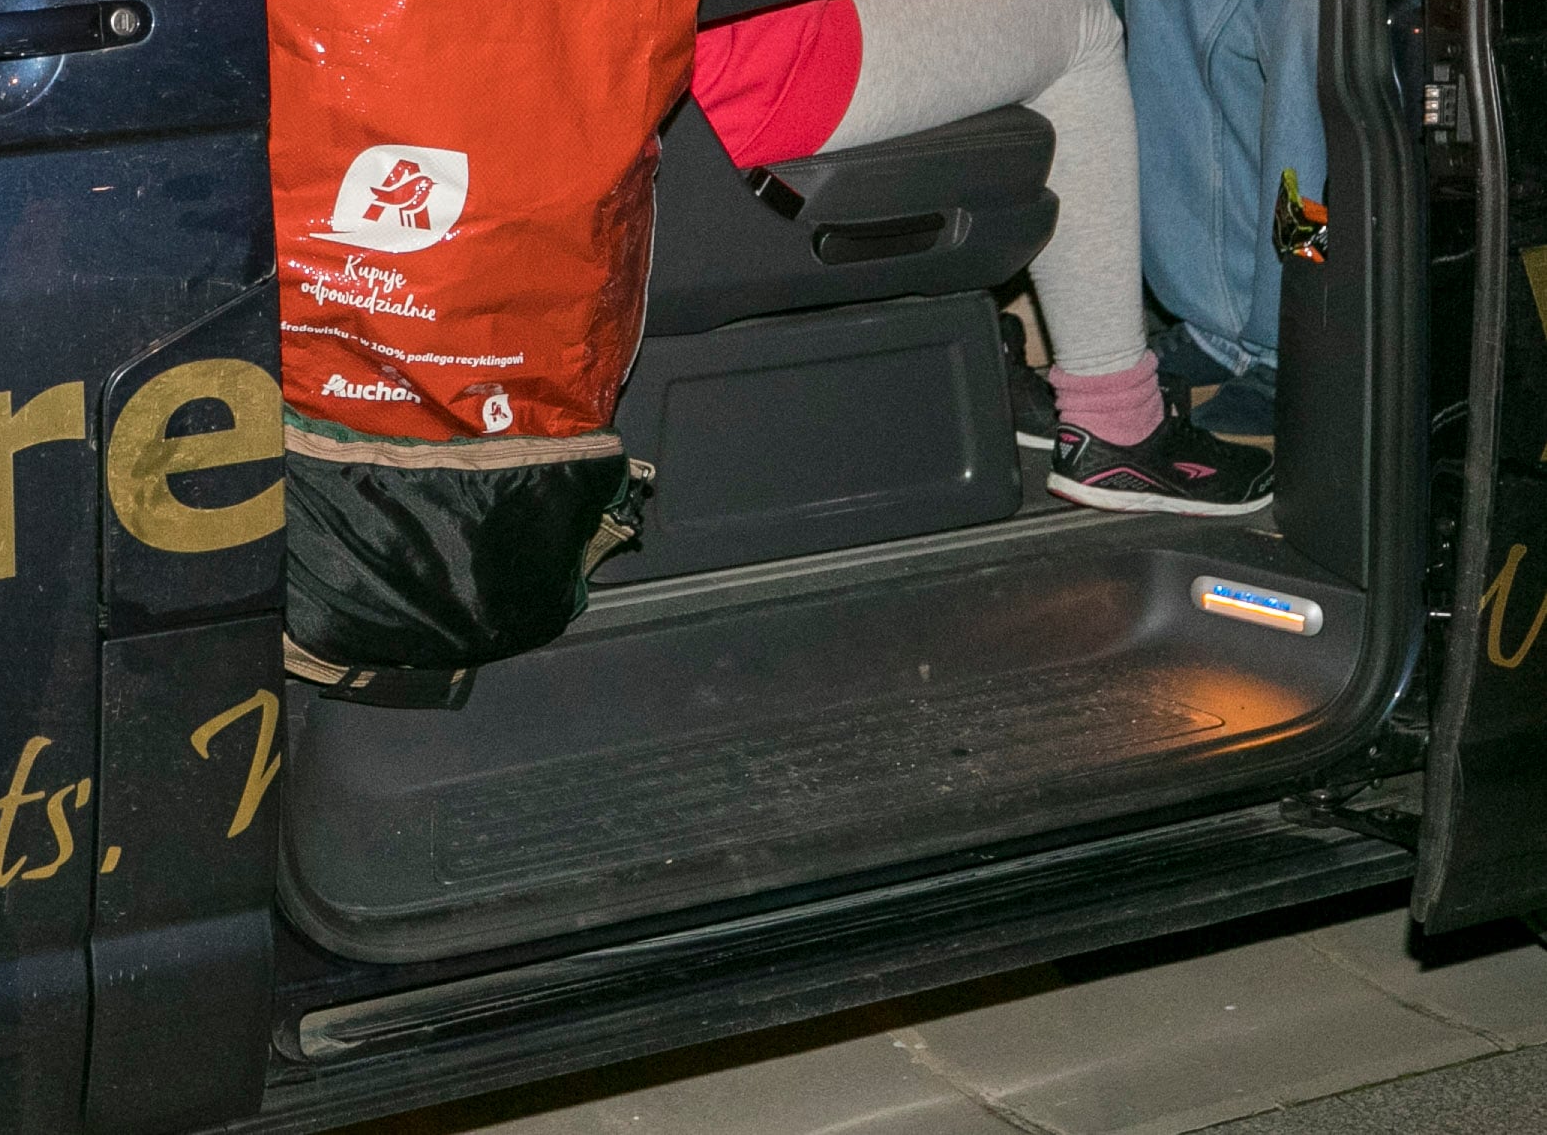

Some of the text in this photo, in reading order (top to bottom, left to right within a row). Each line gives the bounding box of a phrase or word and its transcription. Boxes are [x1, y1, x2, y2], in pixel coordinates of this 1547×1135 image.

[344, 254, 407, 293] Kupuję
[301, 276, 437, 322] odpowiedzialnie
[370, 341, 405, 361] 100%
[406, 352, 454, 366] podlega
[455, 352, 525, 368] recyklingowi
